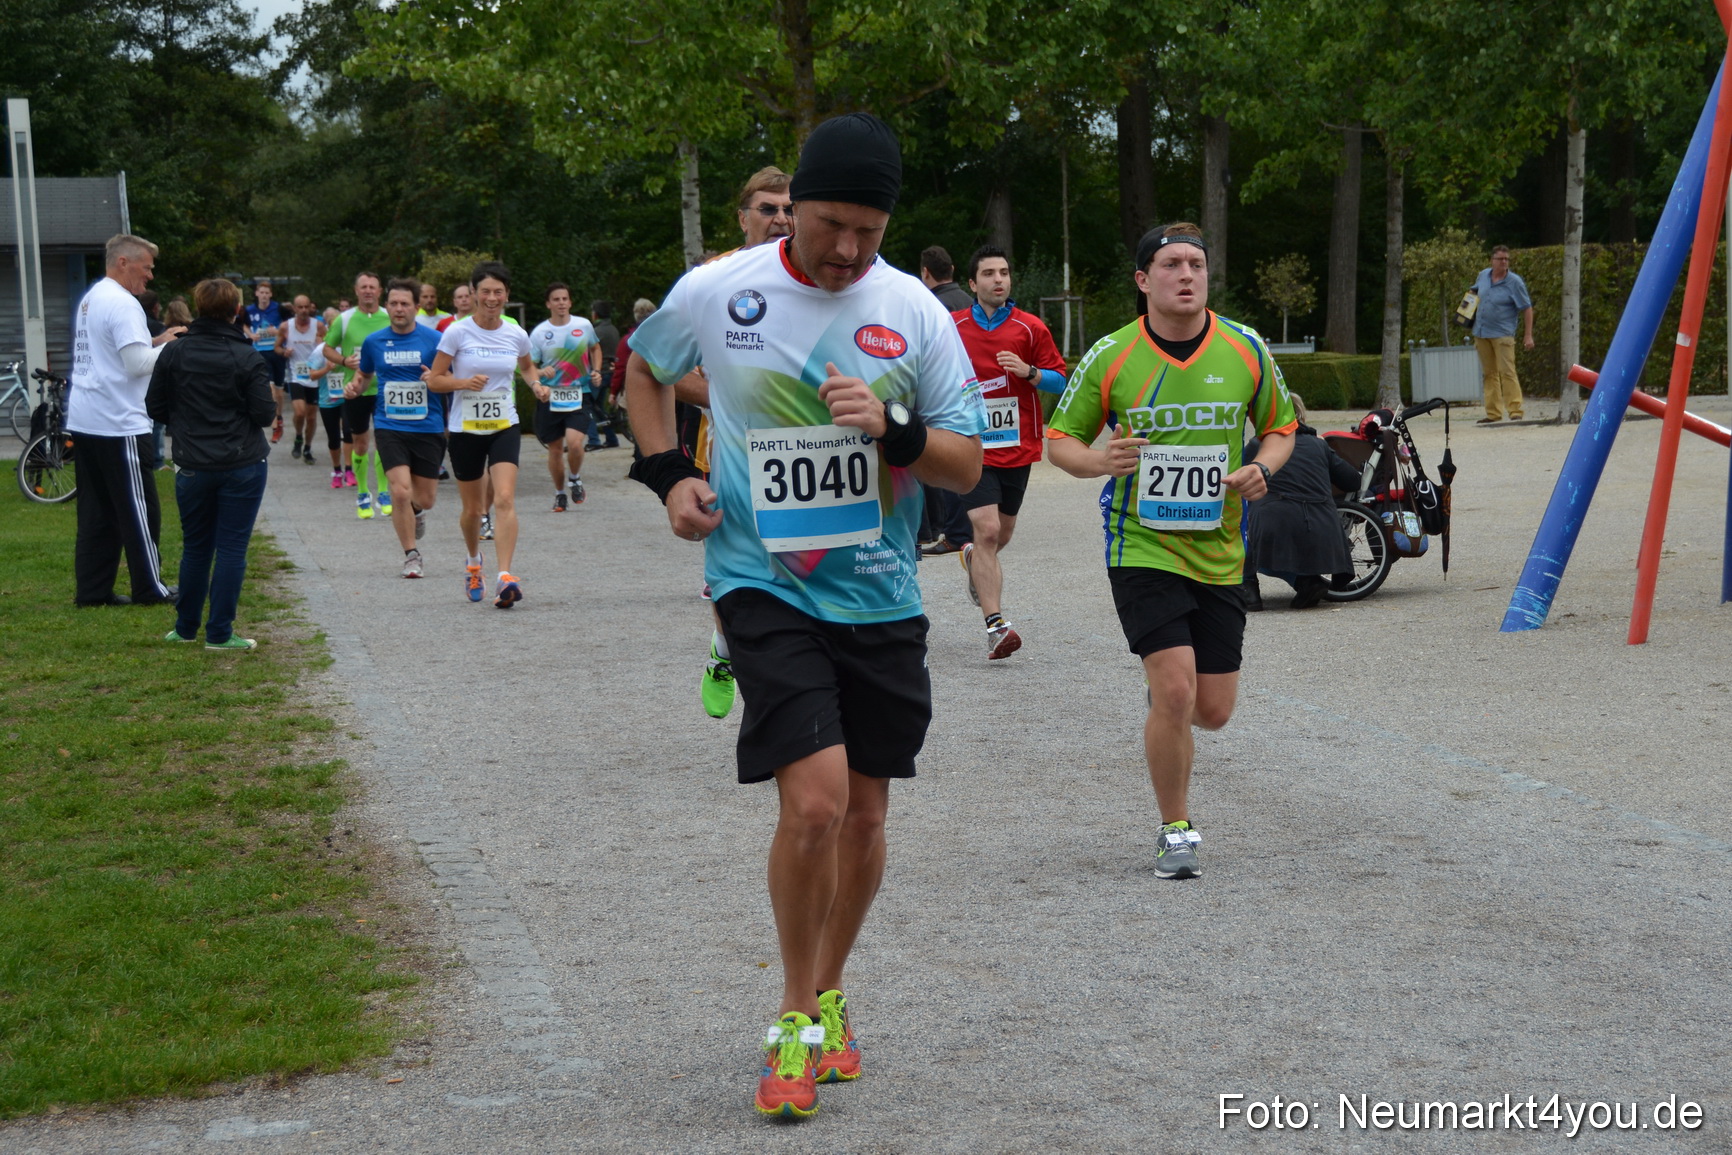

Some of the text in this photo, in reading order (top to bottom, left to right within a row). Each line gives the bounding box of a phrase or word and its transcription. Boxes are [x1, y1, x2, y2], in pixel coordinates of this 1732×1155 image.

[726, 330, 764, 343] PARTL
[862, 330, 901, 351] Hervis
[726, 341, 764, 351] Neumarkt
[384, 350, 422, 360] HUBER
[388, 391, 423, 405] 2193
[553, 391, 579, 401] 3063
[472, 402, 501, 418] 125
[1126, 402, 1242, 434] BOCK
[750, 435, 857, 452] PARTL Neumarkt
[1143, 453, 1216, 463] PARTL Neumarkt
[763, 451, 868, 503] 3040
[1148, 465, 1222, 498] 2709
[1157, 505, 1211, 519] Christian
[854, 559, 900, 574] Stadtlauf
